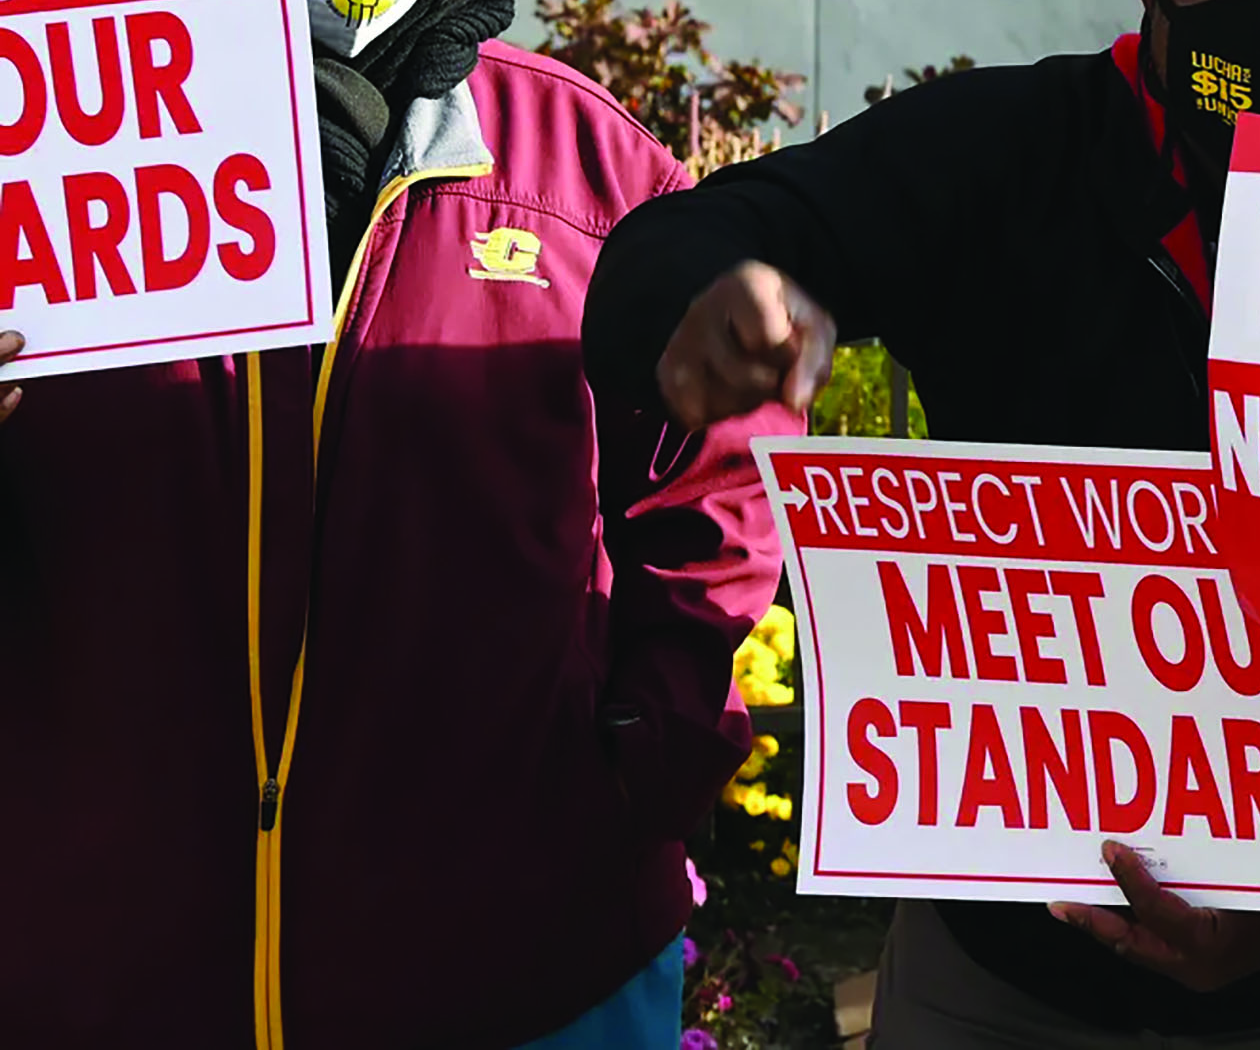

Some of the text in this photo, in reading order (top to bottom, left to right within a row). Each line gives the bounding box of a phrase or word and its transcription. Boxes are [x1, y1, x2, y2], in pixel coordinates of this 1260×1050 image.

[0, 10, 204, 157] OUR
[1191, 70, 1252, 109] $15
[1192, 51, 1241, 82] LUCHA
[0, 153, 276, 311] ARDS
[803, 465, 1219, 554] RESPECT WOR
[876, 560, 1106, 688] MEET
